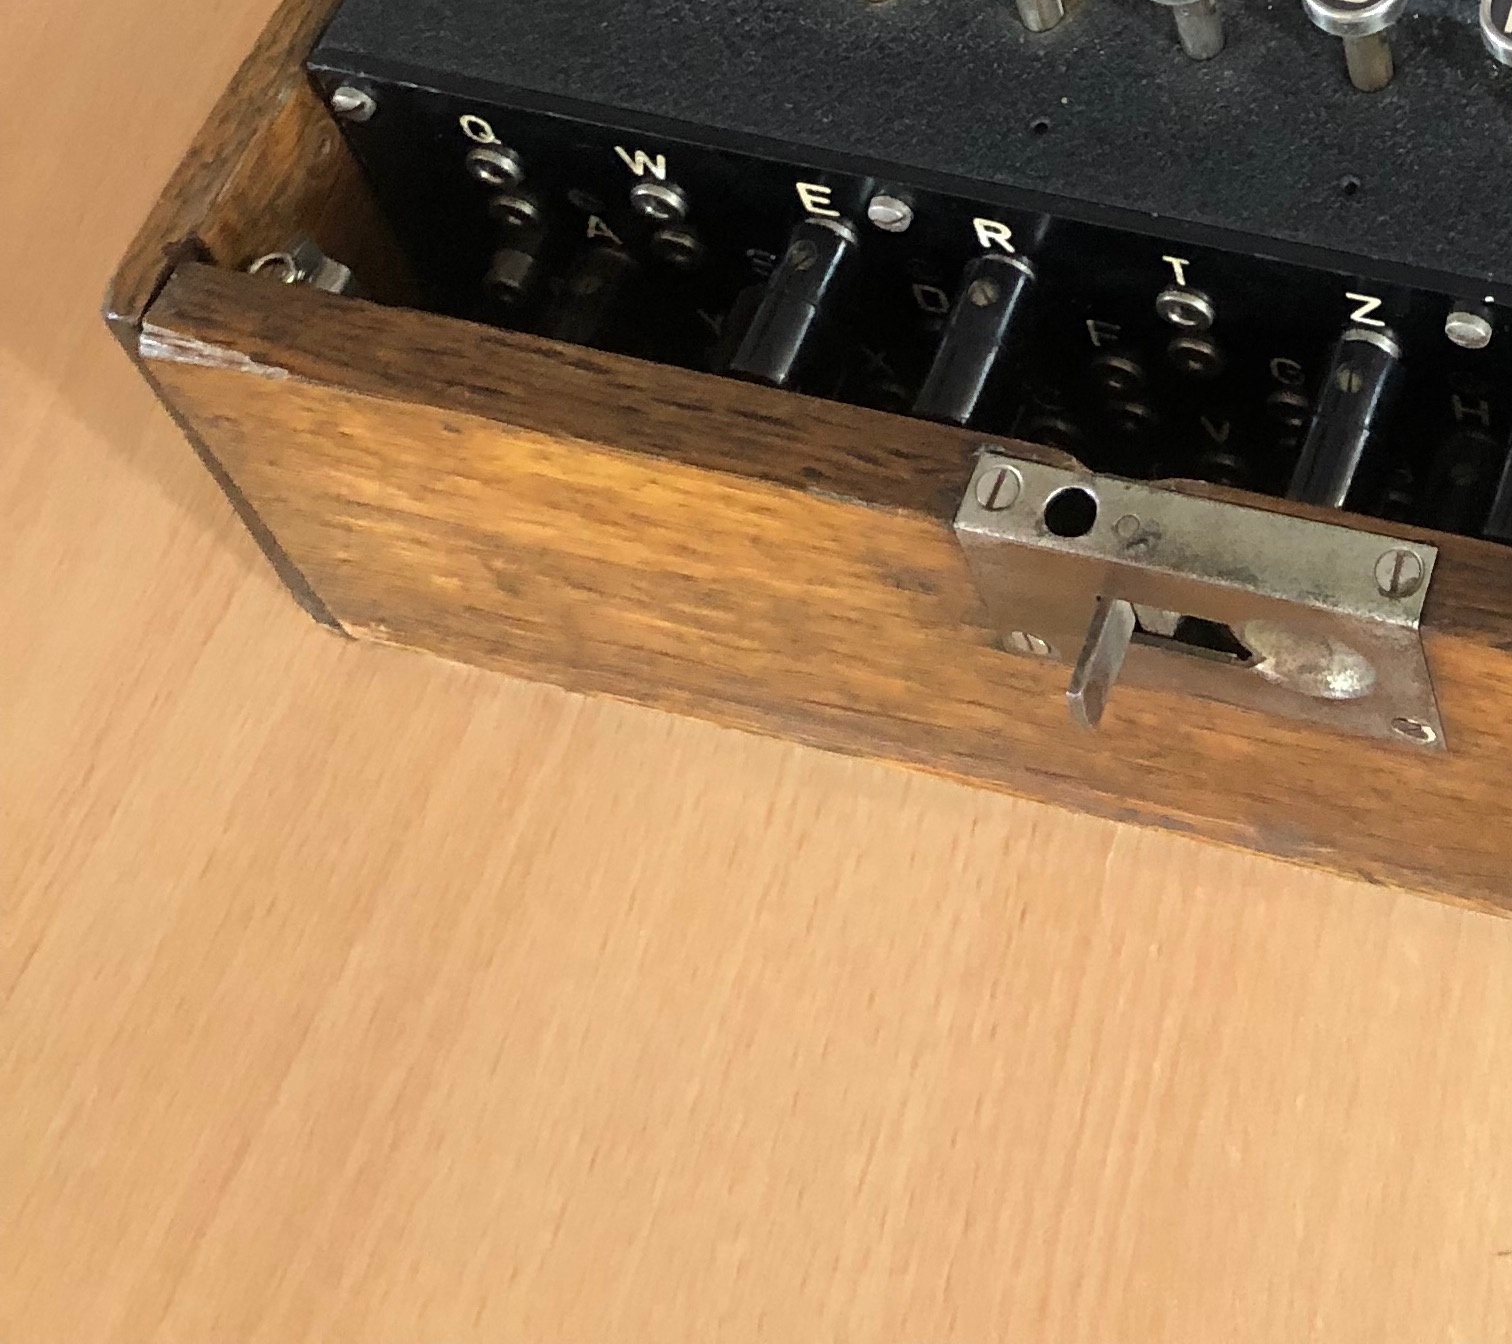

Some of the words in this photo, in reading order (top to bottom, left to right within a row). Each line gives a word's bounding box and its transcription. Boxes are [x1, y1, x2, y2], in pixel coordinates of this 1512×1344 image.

[459, 114, 502, 145] Q
[614, 145, 666, 180] W
[795, 181, 841, 217] E
[972, 217, 1016, 253] R
[1162, 255, 1190, 286] T
[1345, 292, 1386, 327] Z
